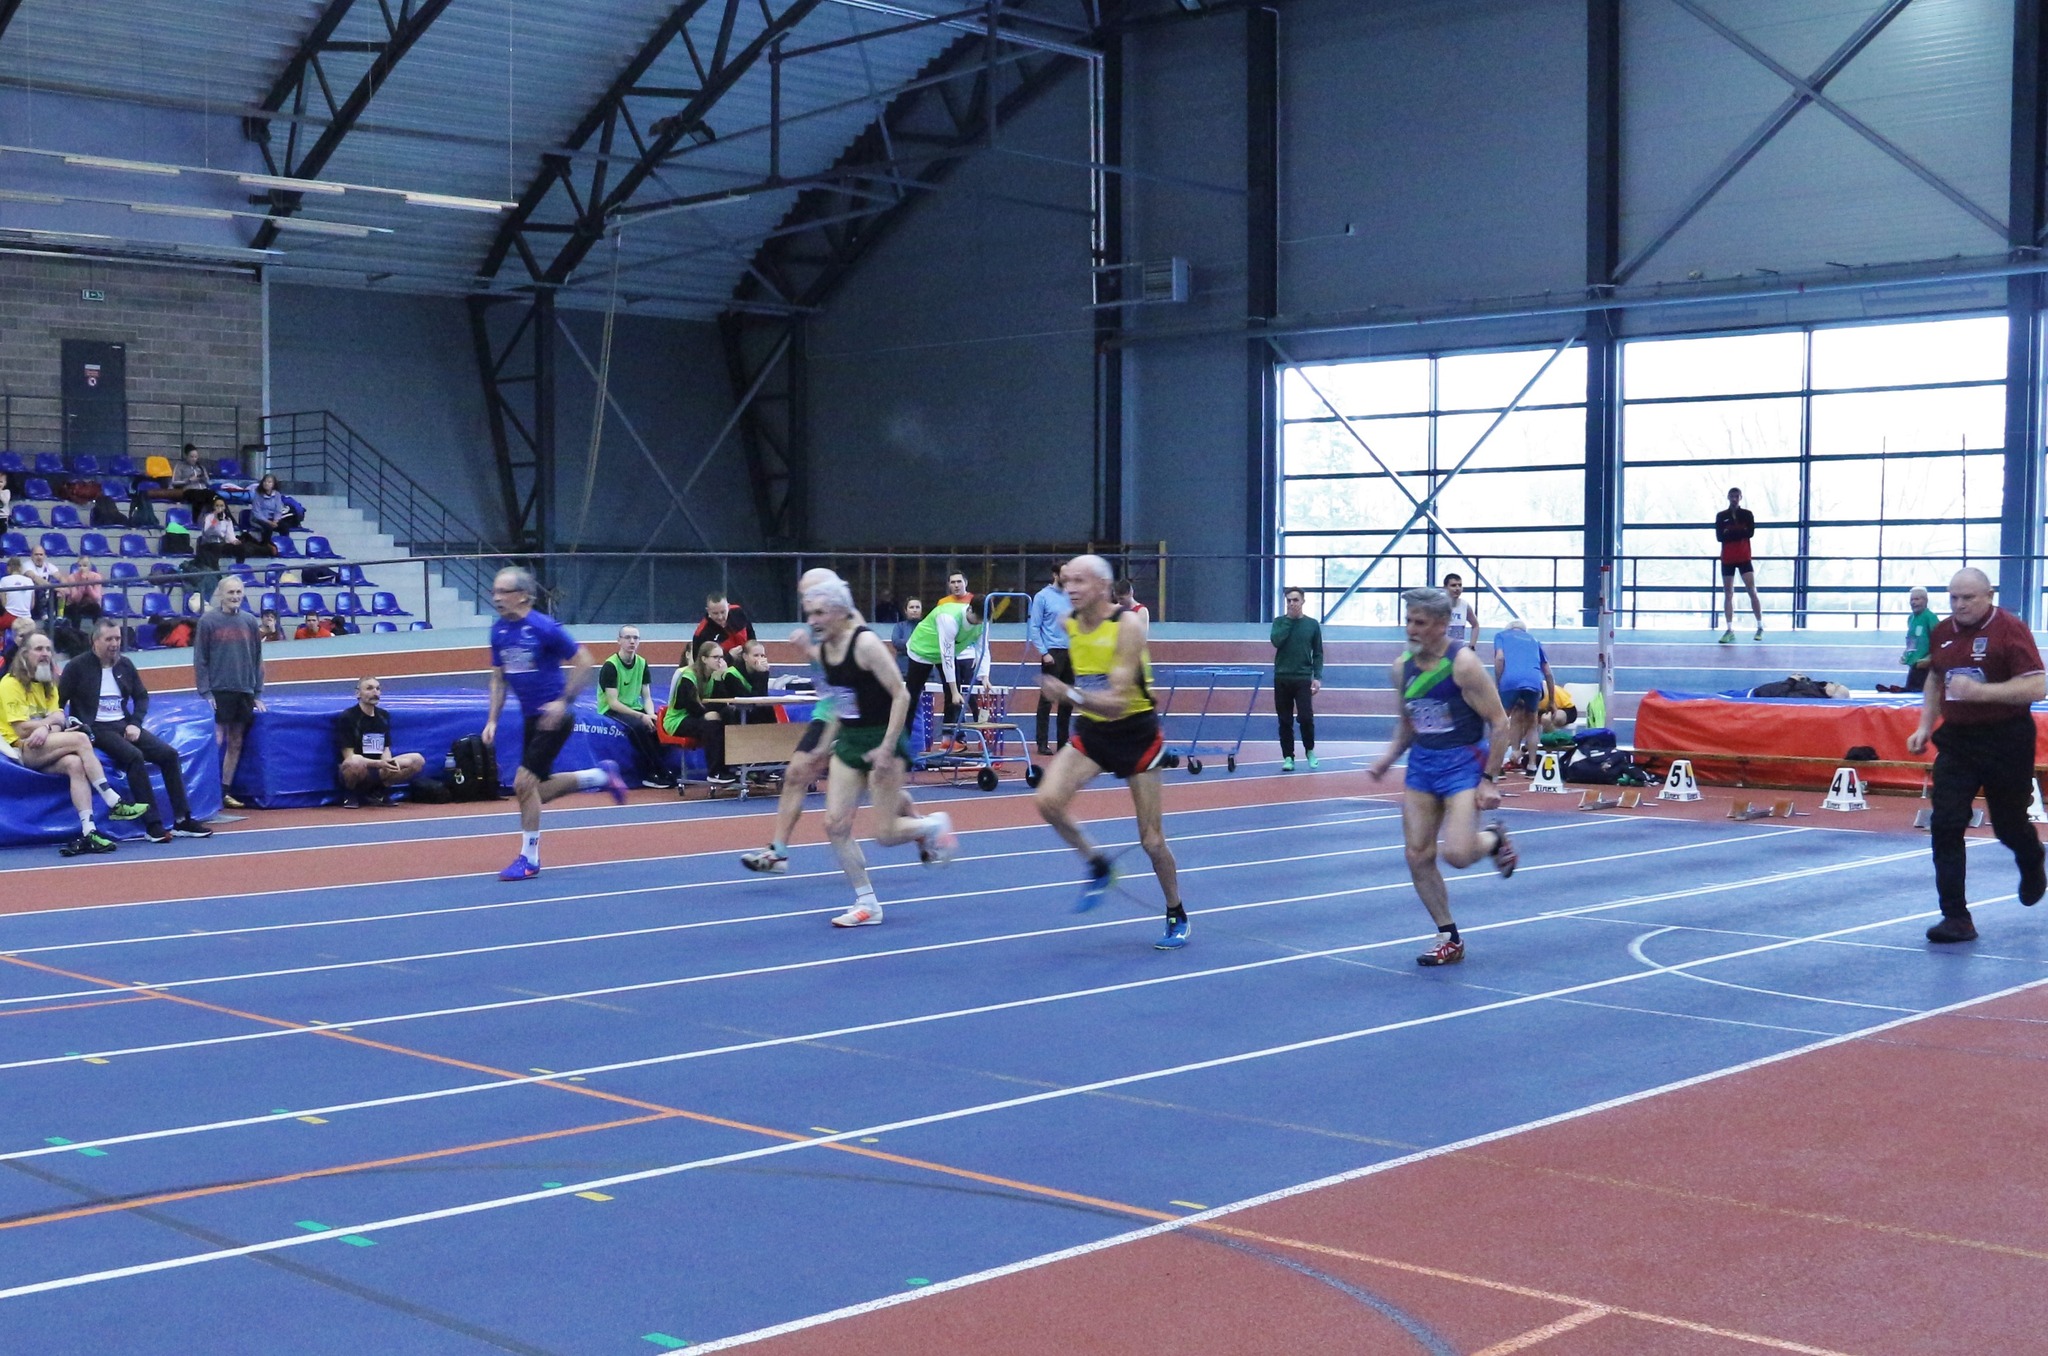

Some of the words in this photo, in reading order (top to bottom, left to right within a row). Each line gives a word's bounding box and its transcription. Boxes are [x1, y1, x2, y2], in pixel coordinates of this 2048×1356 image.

[1542, 757, 1555, 781] 6
[1670, 765, 1682, 788] 5
[1831, 773, 1843, 796] 4
[1847, 771, 1857, 797] 4
